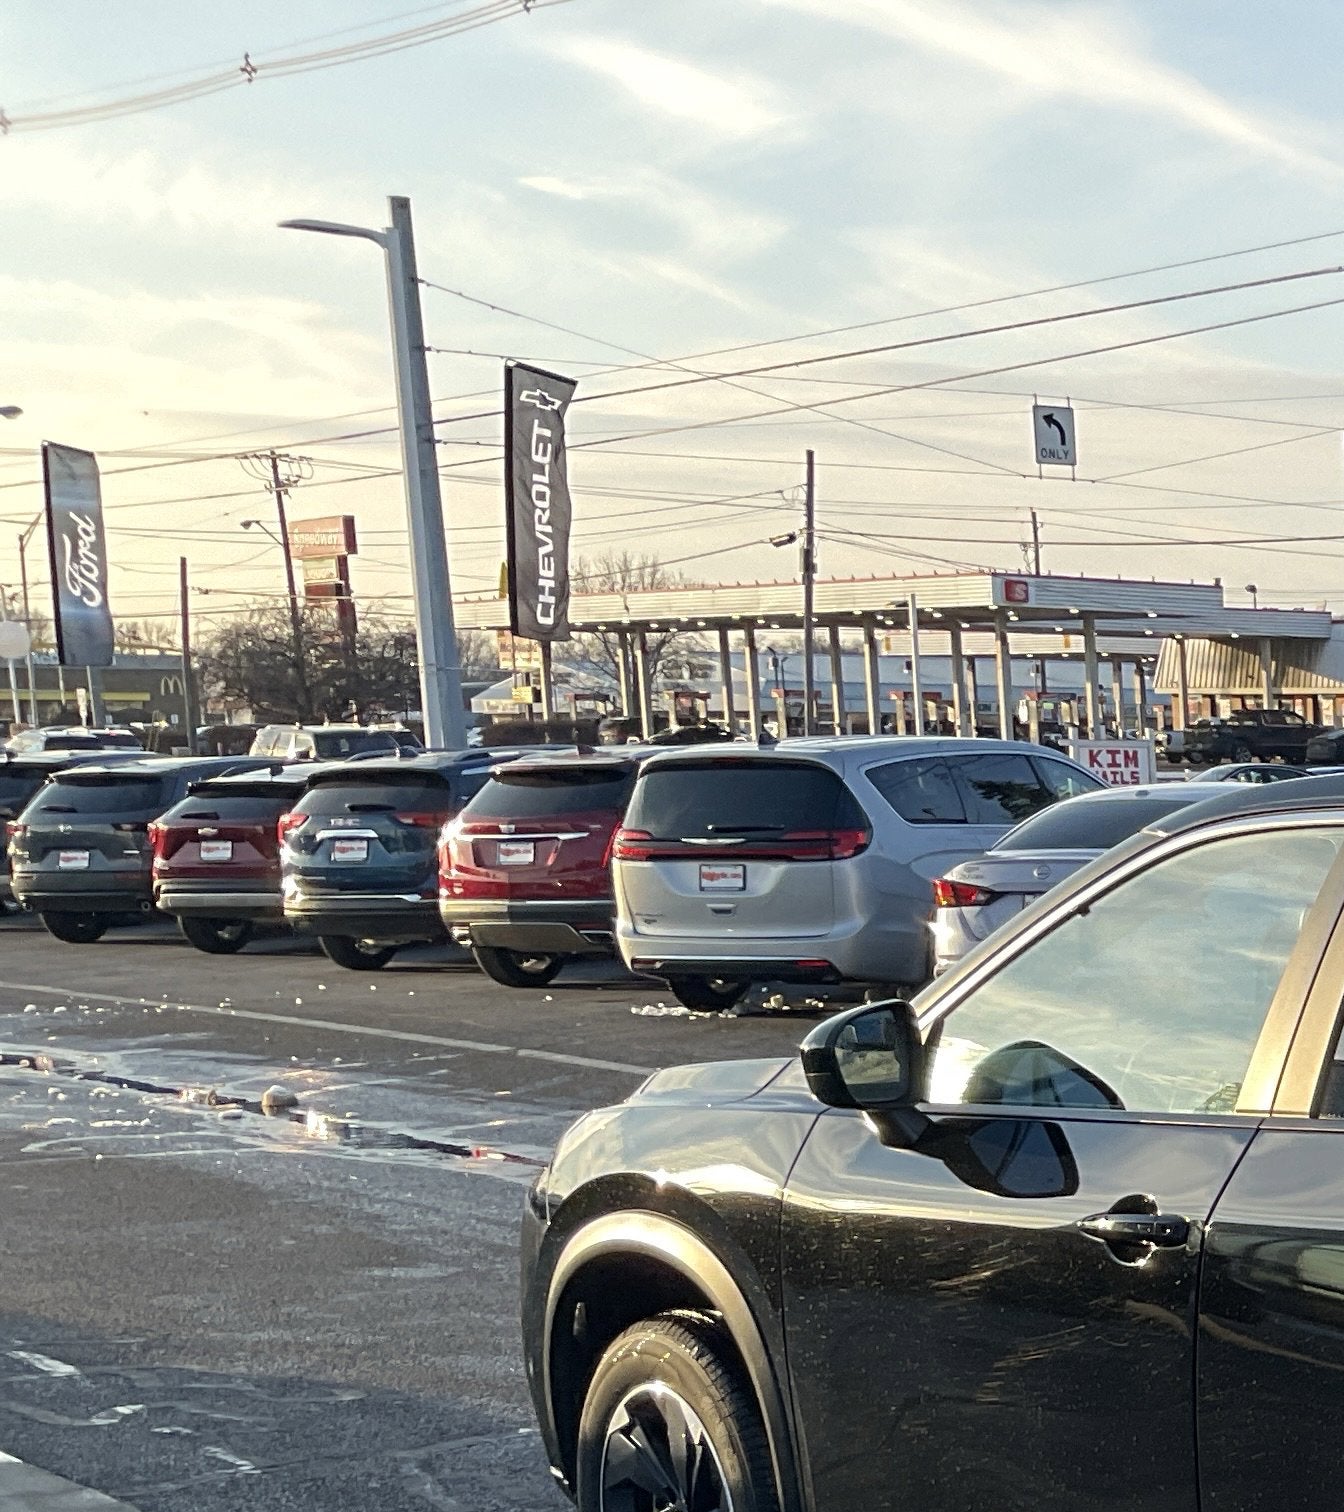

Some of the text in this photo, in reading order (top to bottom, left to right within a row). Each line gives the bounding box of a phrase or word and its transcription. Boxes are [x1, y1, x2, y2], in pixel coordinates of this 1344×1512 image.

[1041, 447, 1070, 460] ONLY
[531, 419, 555, 625] CHEVROLET
[62, 511, 102, 608] Ford
[1088, 749, 1139, 769] KIM
[1095, 770, 1140, 785] AILS
